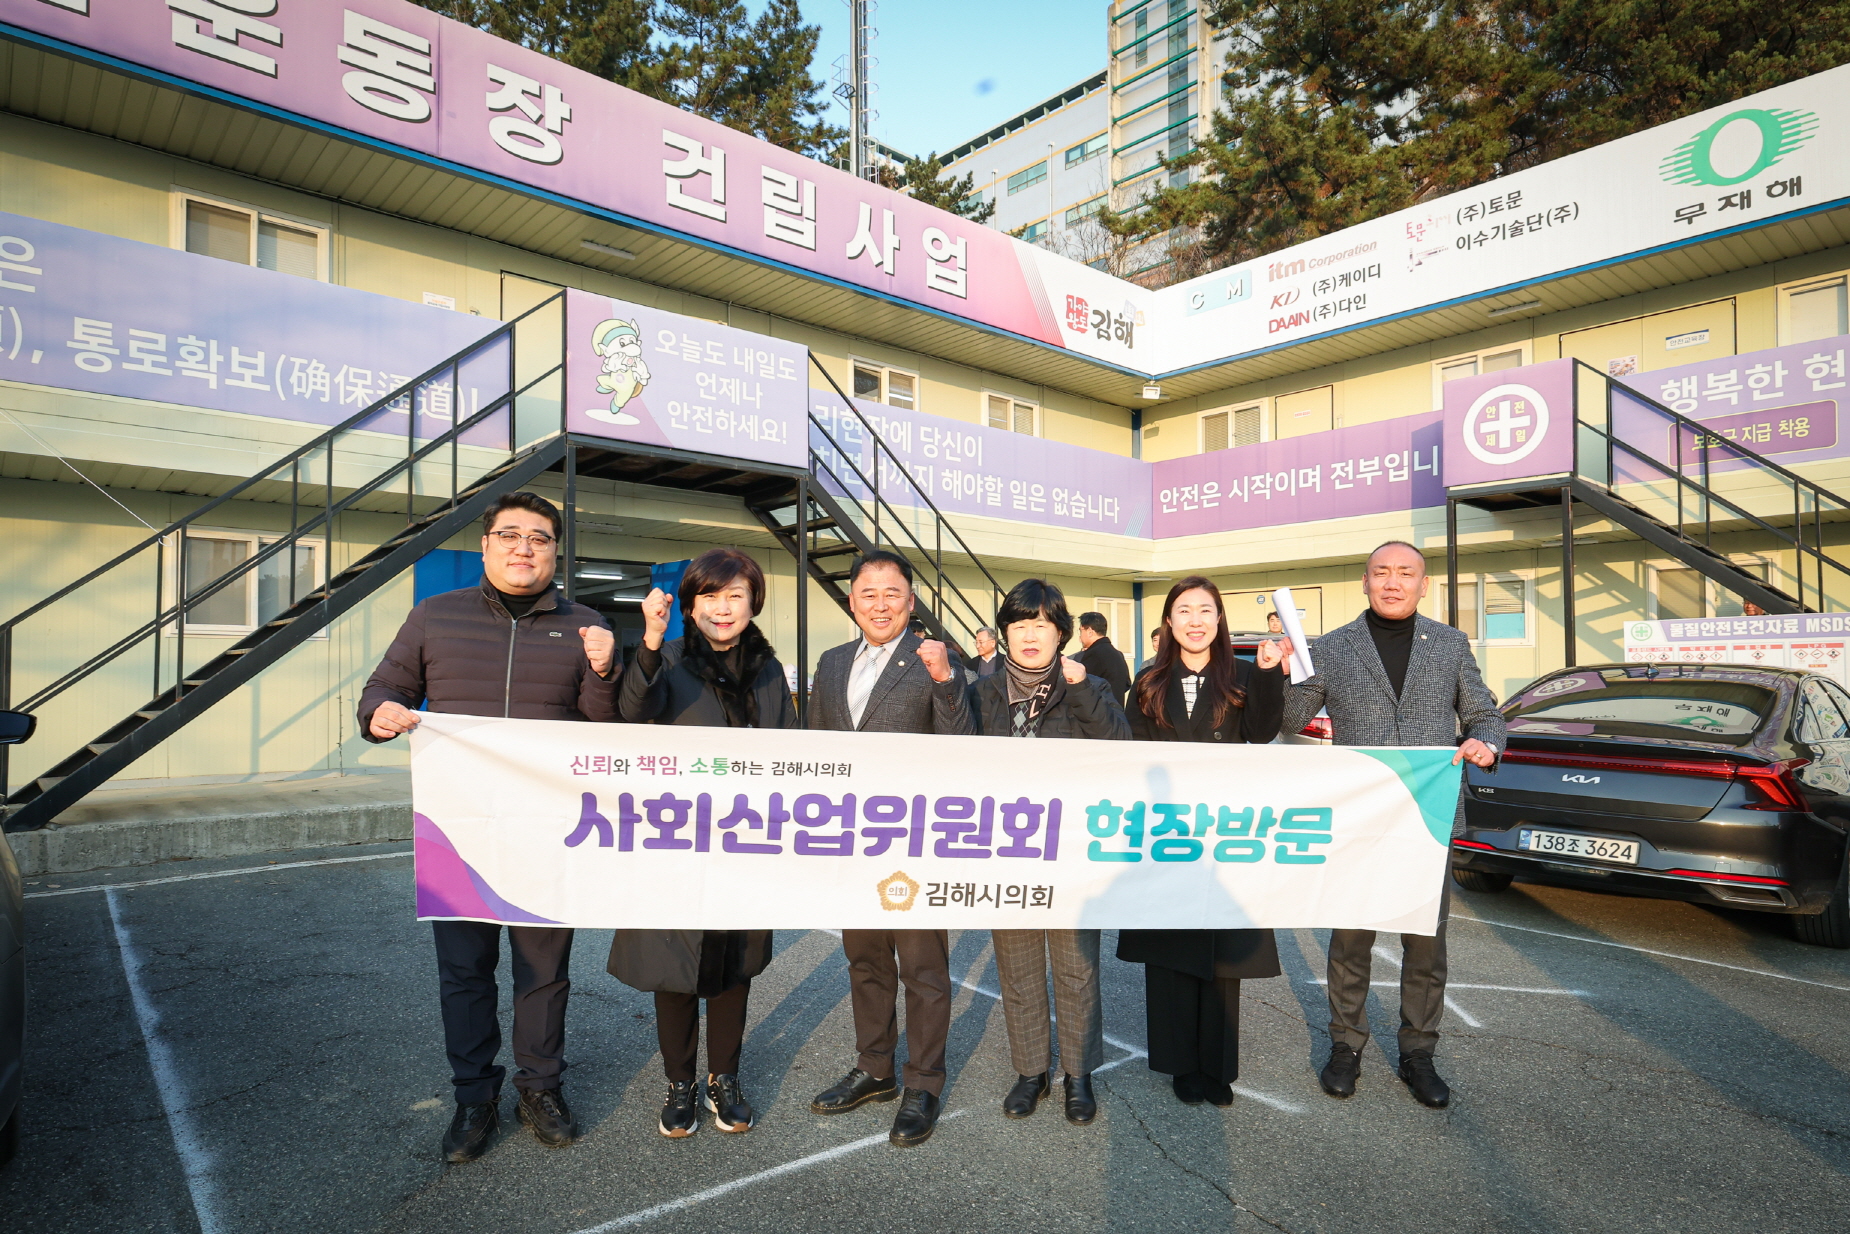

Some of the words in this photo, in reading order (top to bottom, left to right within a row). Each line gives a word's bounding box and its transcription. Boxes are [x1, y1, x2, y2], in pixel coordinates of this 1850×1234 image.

[662, 128, 968, 300] 건립사업
[1456, 190, 1523, 226] (주)토문
[1456, 201, 1580, 251] 이수기술단(주)
[1268, 258, 1306, 283] itm
[1308, 240, 1378, 269] Corporation
[1312, 263, 1381, 297] (주)케이디
[1312, 293, 1367, 322] (주)다인
[1090, 309, 1134, 350] 김해
[654, 329, 727, 366] 오늘도
[733, 346, 798, 381] 내일도
[695, 371, 764, 410] 언제나
[1660, 360, 1789, 415] 행복한
[1802, 349, 1847, 392] 현
[667, 400, 787, 445] 안전하세요!
[1741, 422, 1772, 443] 지급
[1778, 417, 1811, 439] 착용
[919, 425, 983, 467] 당신이
[941, 468, 1004, 507] 해야할
[1009, 480, 1047, 513] 일은
[1052, 487, 1121, 524] 없습니다
[1159, 481, 1222, 514] 안전은
[1228, 464, 1321, 503] 시작이며
[1669, 618, 1799, 638] 물질안전보건자료
[569, 755, 631, 776] 신뢰와
[636, 755, 683, 777] 책임,
[689, 757, 765, 776] 소통하는
[771, 761, 853, 778] 김해시의회
[563, 791, 1063, 862] 사회산업위원회
[1084, 798, 1333, 865] 현장방문
[1534, 833, 1580, 853] 138조
[1585, 839, 1633, 861] 3624
[887, 886, 908, 897] 의회
[925, 882, 1054, 909] 김해시의회
